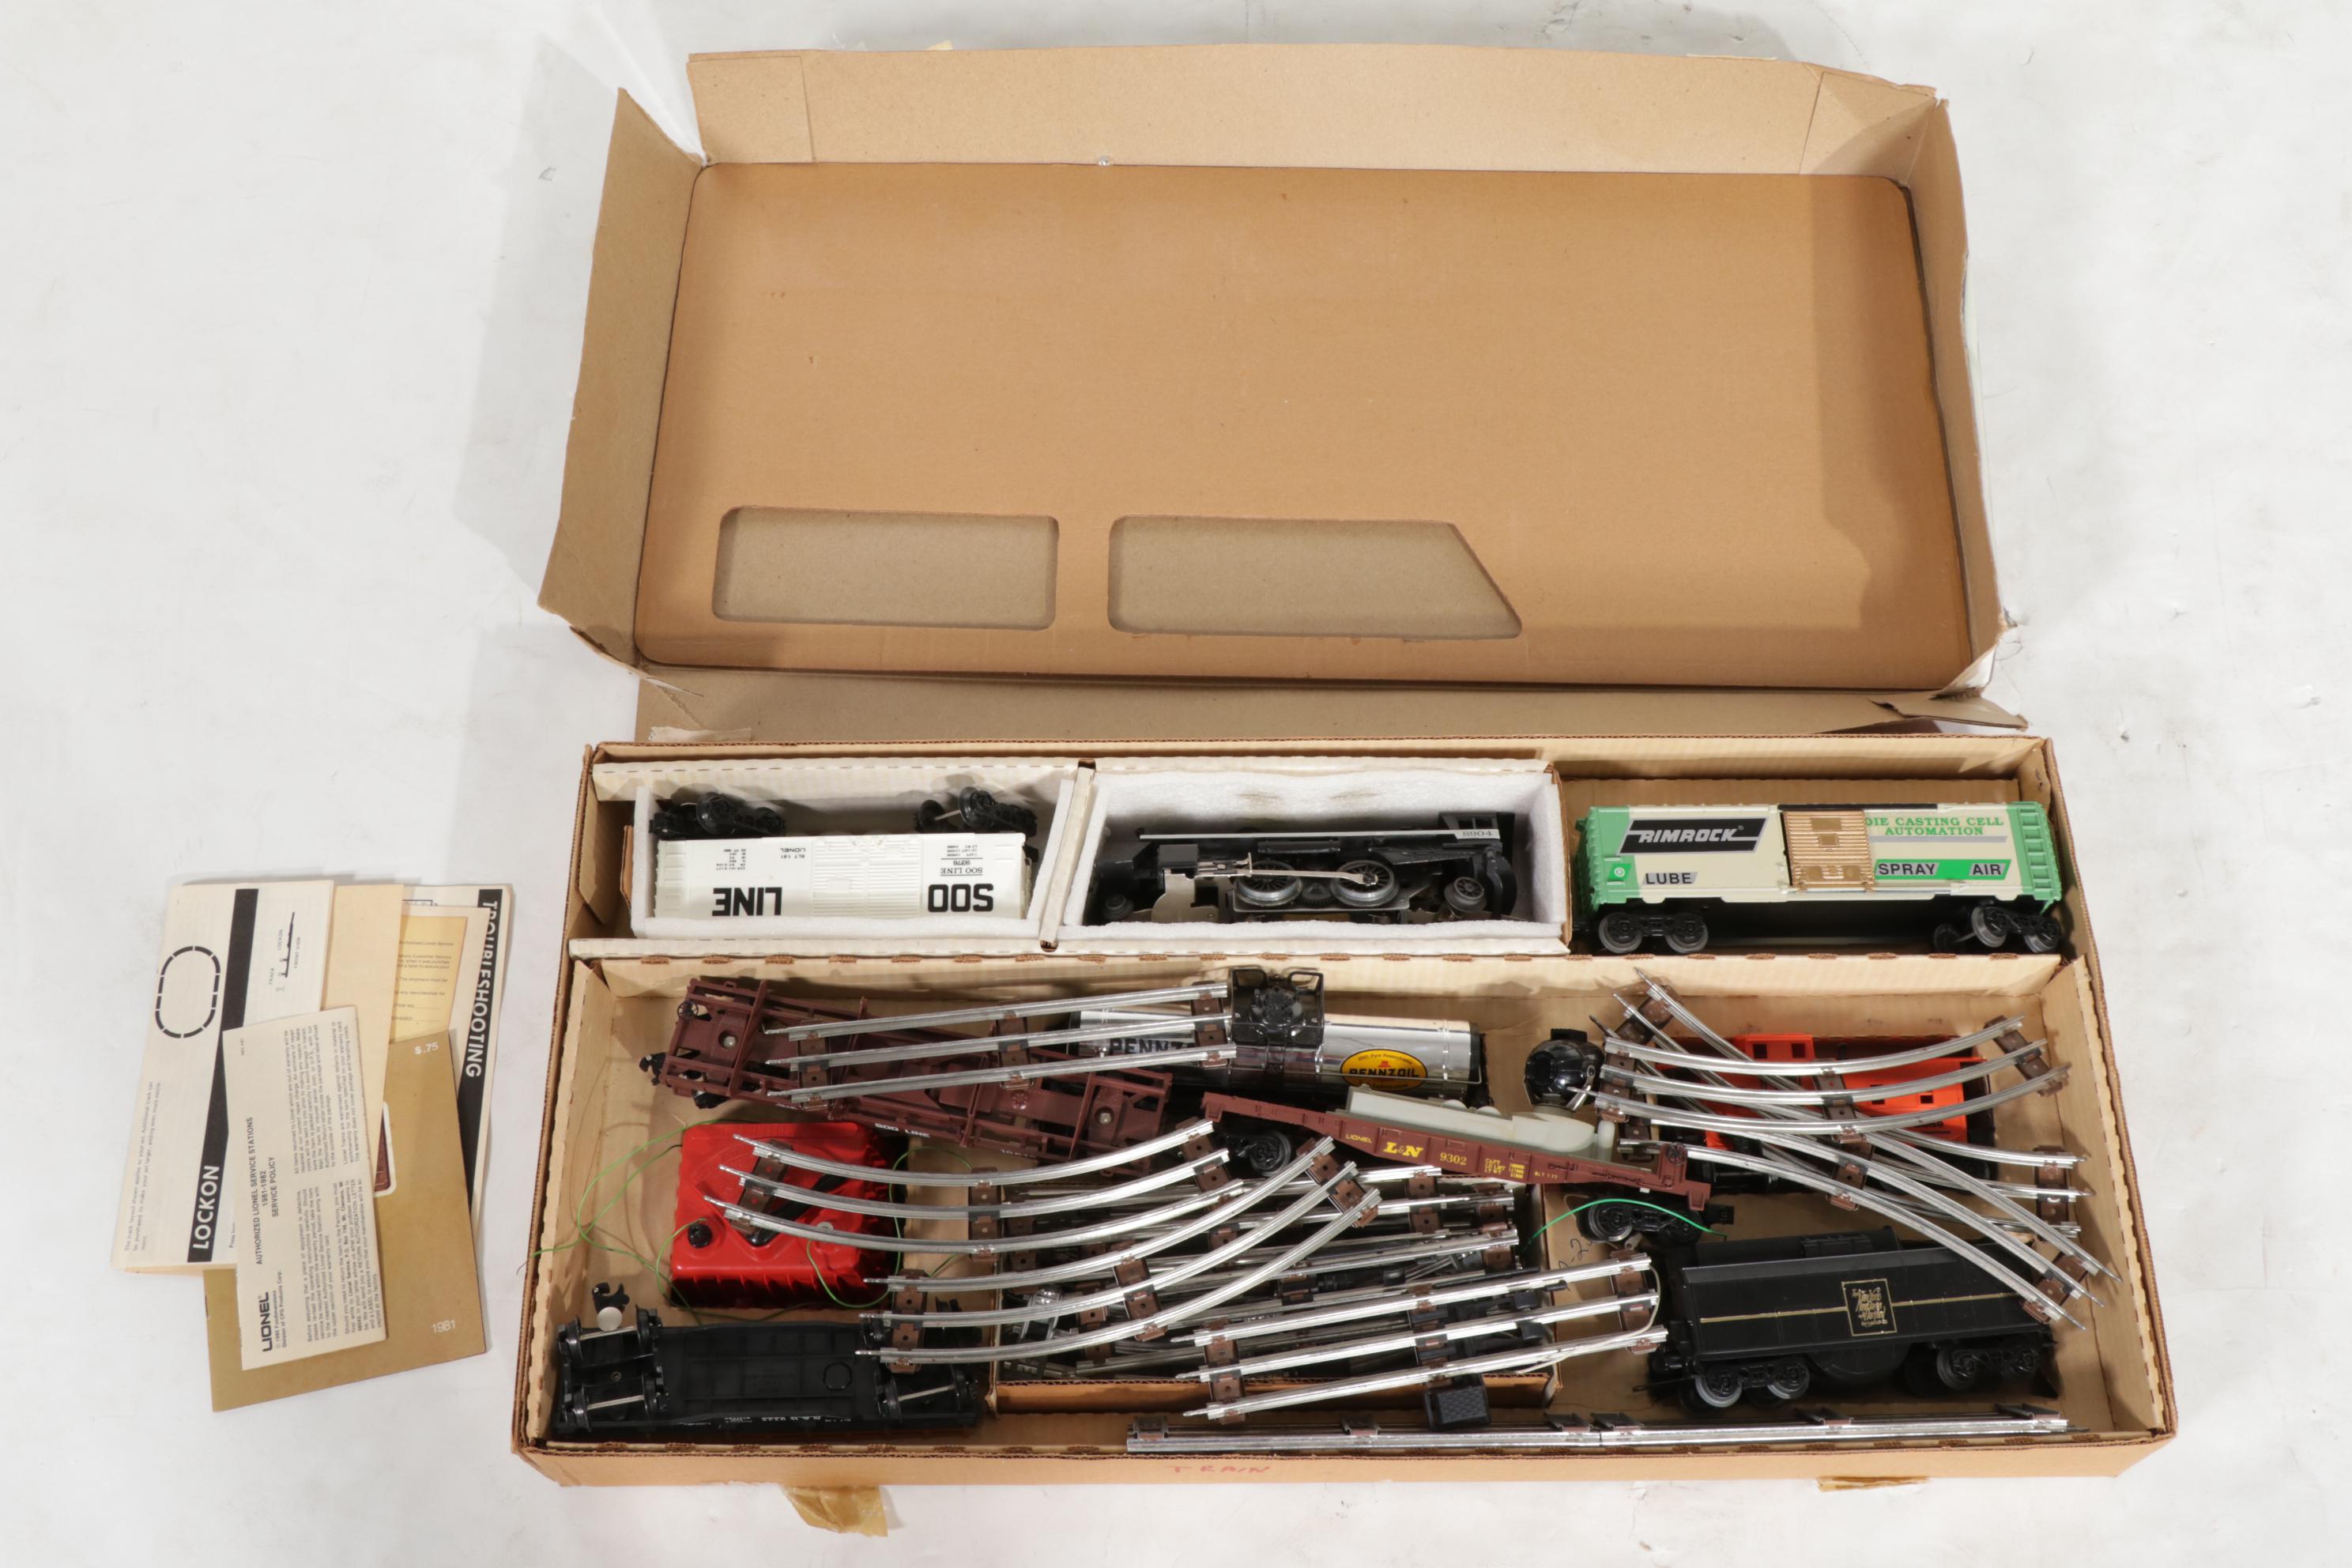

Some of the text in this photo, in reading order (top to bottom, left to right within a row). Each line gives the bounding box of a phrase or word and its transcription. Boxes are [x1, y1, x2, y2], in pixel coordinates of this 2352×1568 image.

[1895, 817, 1959, 826] CASTING
[1638, 829, 1737, 842] RIMROCK
[1879, 864, 2002, 875] SPRAY AIR
[1645, 873, 1693, 884] LUBE
[711, 883, 994, 916] SOO LINE
[1348, 1068, 1419, 1078] PENNZOIL
[247, 1117, 255, 1154] STATIONS
[875, 1122, 930, 1138] SOO LINE
[1346, 1133, 1372, 1144] LIONEL
[1384, 1141, 1423, 1157] L&N
[1440, 1152, 1468, 1166] 9302
[249, 1155, 258, 1186] SERVICE
[193, 1165, 220, 1250] LOCKON
[270, 1185, 279, 1216] SERVICE
[253, 1217, 262, 1265] AUTHORIZED
[259, 1291, 273, 1352] LIONEL
[432, 1319, 456, 1334] 1981
